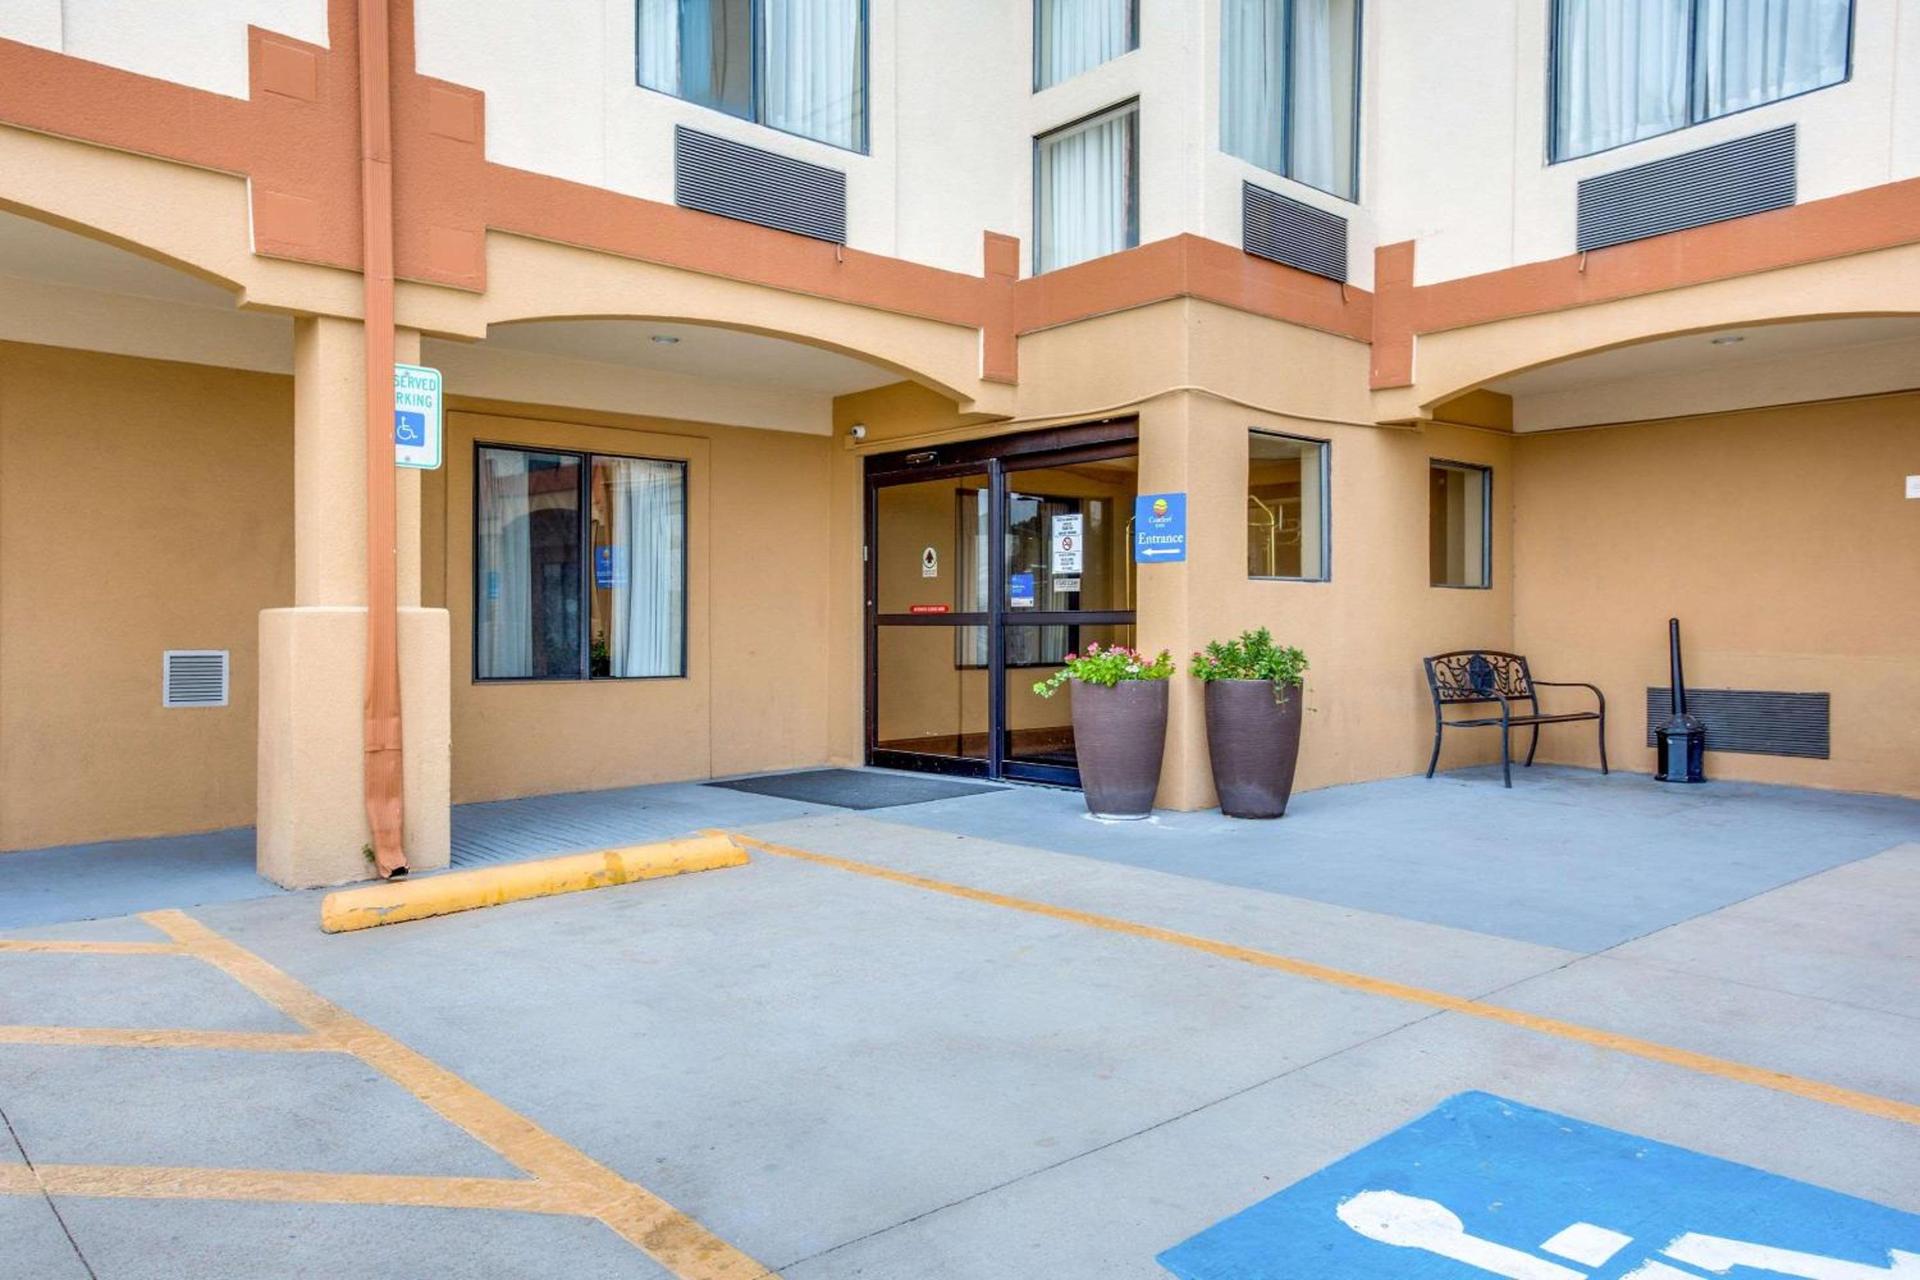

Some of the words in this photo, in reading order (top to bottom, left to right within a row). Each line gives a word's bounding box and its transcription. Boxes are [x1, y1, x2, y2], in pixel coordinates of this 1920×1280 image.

[394, 375, 436, 391] SERVED
[397, 392, 432, 408] RKING
[1138, 532, 1184, 545] Entrance
